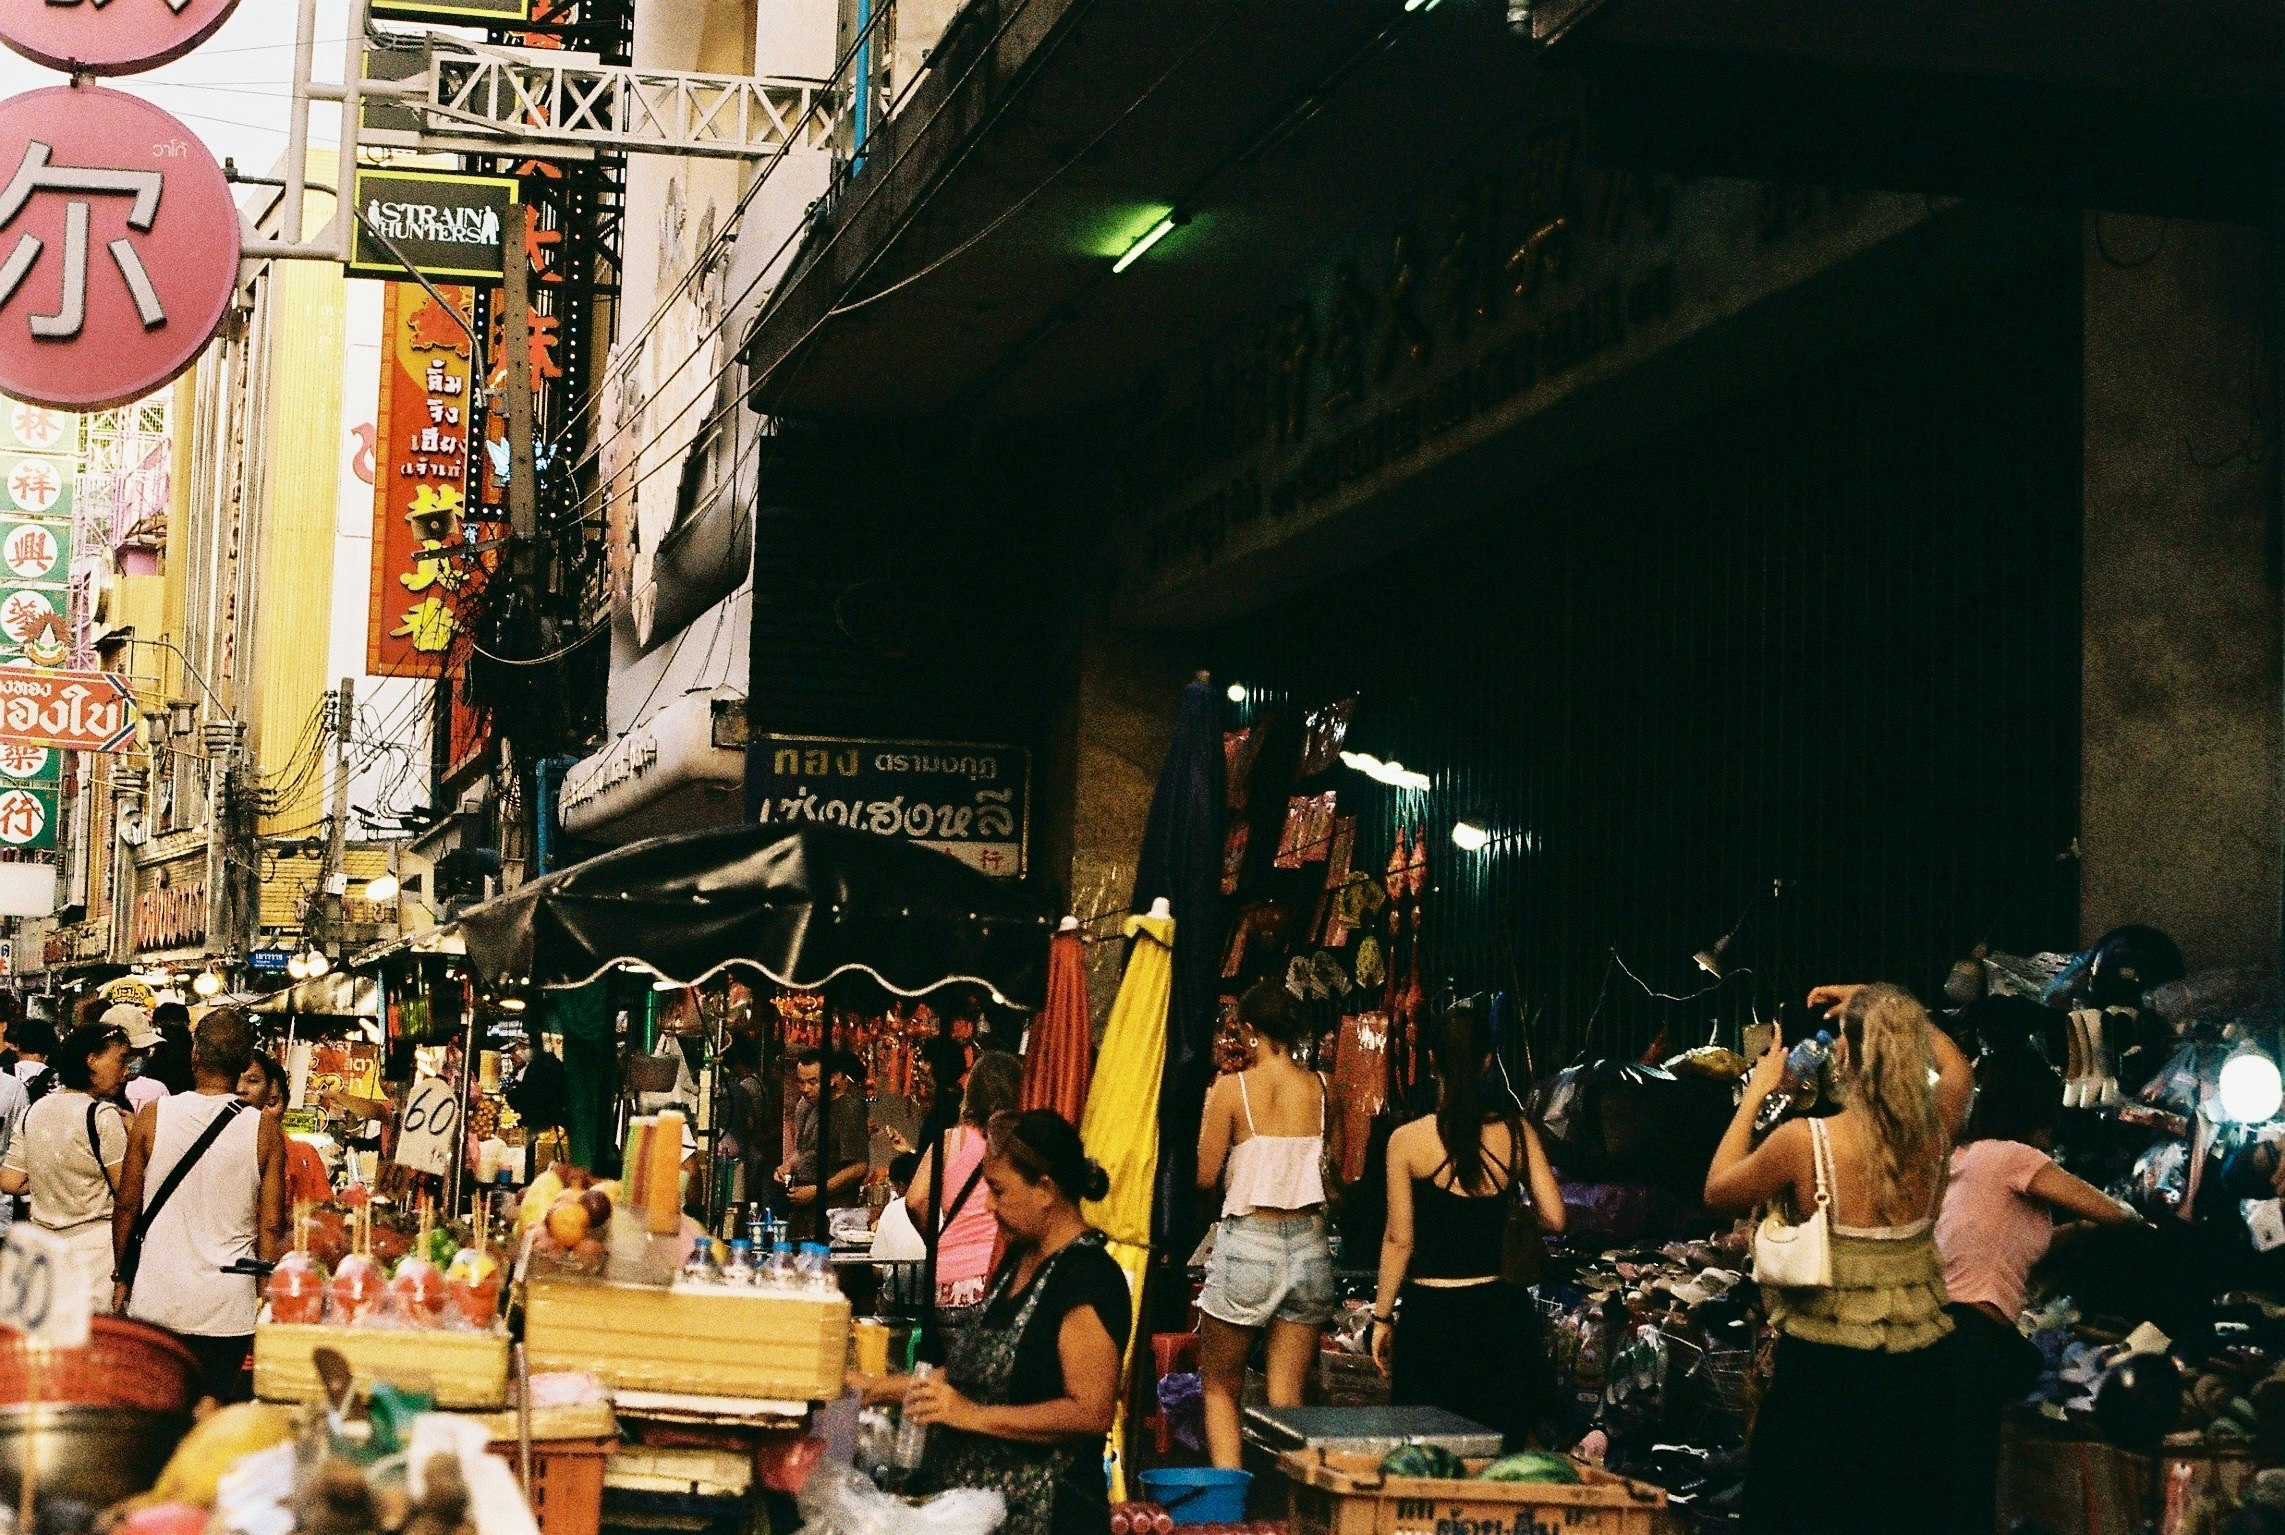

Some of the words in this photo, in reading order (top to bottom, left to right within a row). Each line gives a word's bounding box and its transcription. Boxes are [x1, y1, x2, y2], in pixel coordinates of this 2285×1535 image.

[379, 221, 482, 244] HUNTERS
[380, 202, 484, 228] STRAIN
[0, 684, 118, 738] องใบ
[404, 1087, 456, 1136] 60
